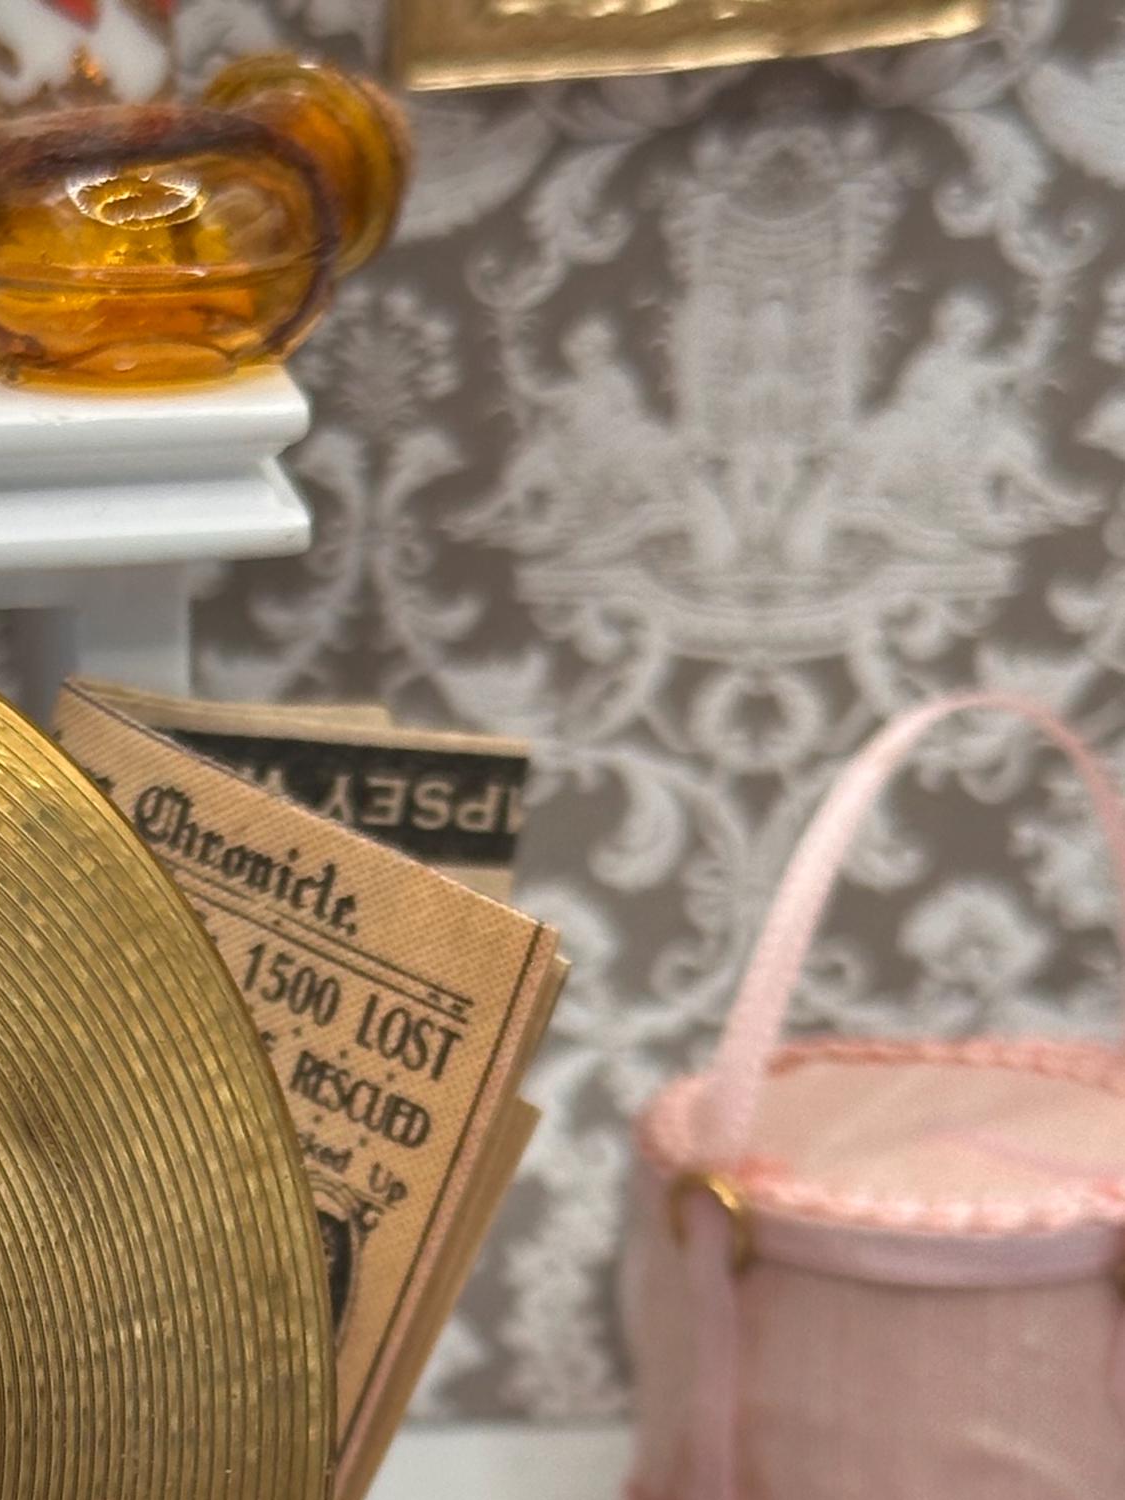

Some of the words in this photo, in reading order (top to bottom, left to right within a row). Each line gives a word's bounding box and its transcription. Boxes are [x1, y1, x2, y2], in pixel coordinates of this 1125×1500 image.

[134, 785, 357, 935] Chronicle.
[244, 943, 341, 1027] 1500
[355, 993, 464, 1081] LOST
[289, 1050, 430, 1148] RESCUED
